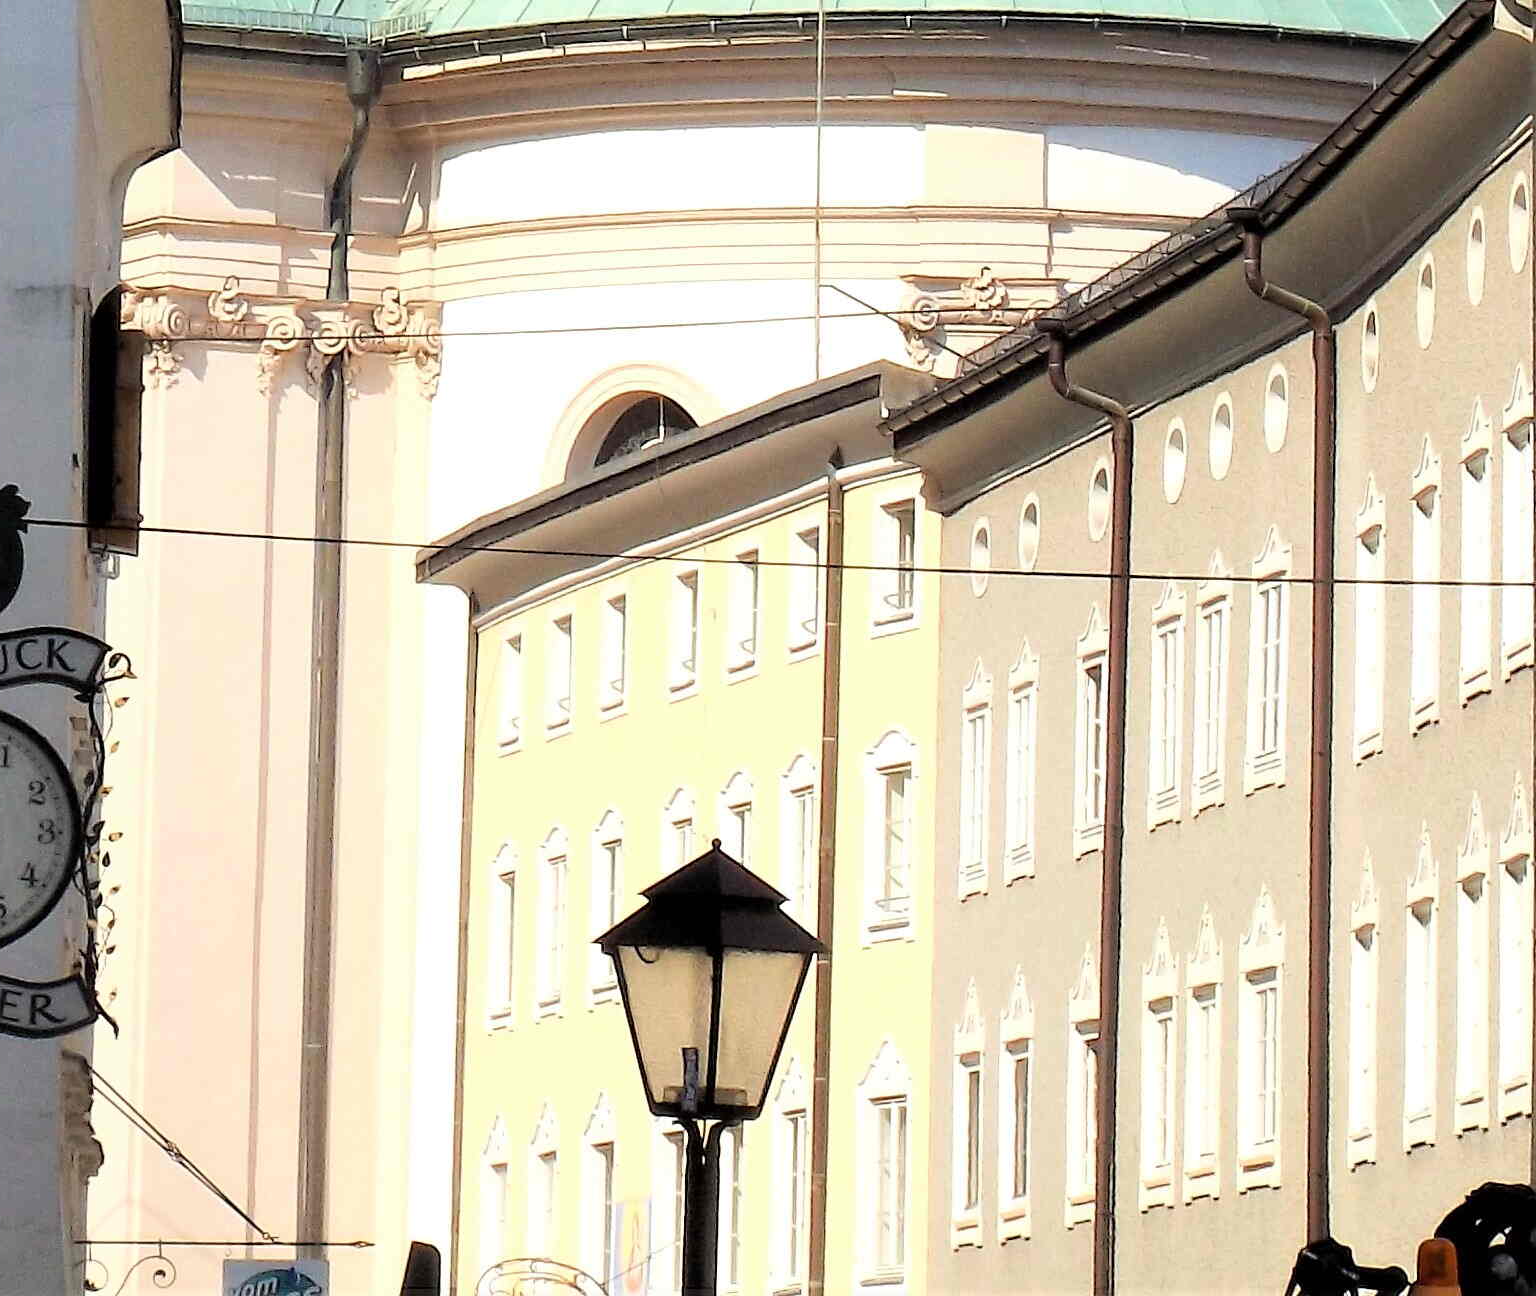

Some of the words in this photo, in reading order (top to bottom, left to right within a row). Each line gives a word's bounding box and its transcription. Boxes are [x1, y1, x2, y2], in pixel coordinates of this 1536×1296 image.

[0, 744, 11, 769] 1
[28, 780, 46, 805] 2
[37, 818, 56, 844] 3
[20, 862, 39, 888] 4
